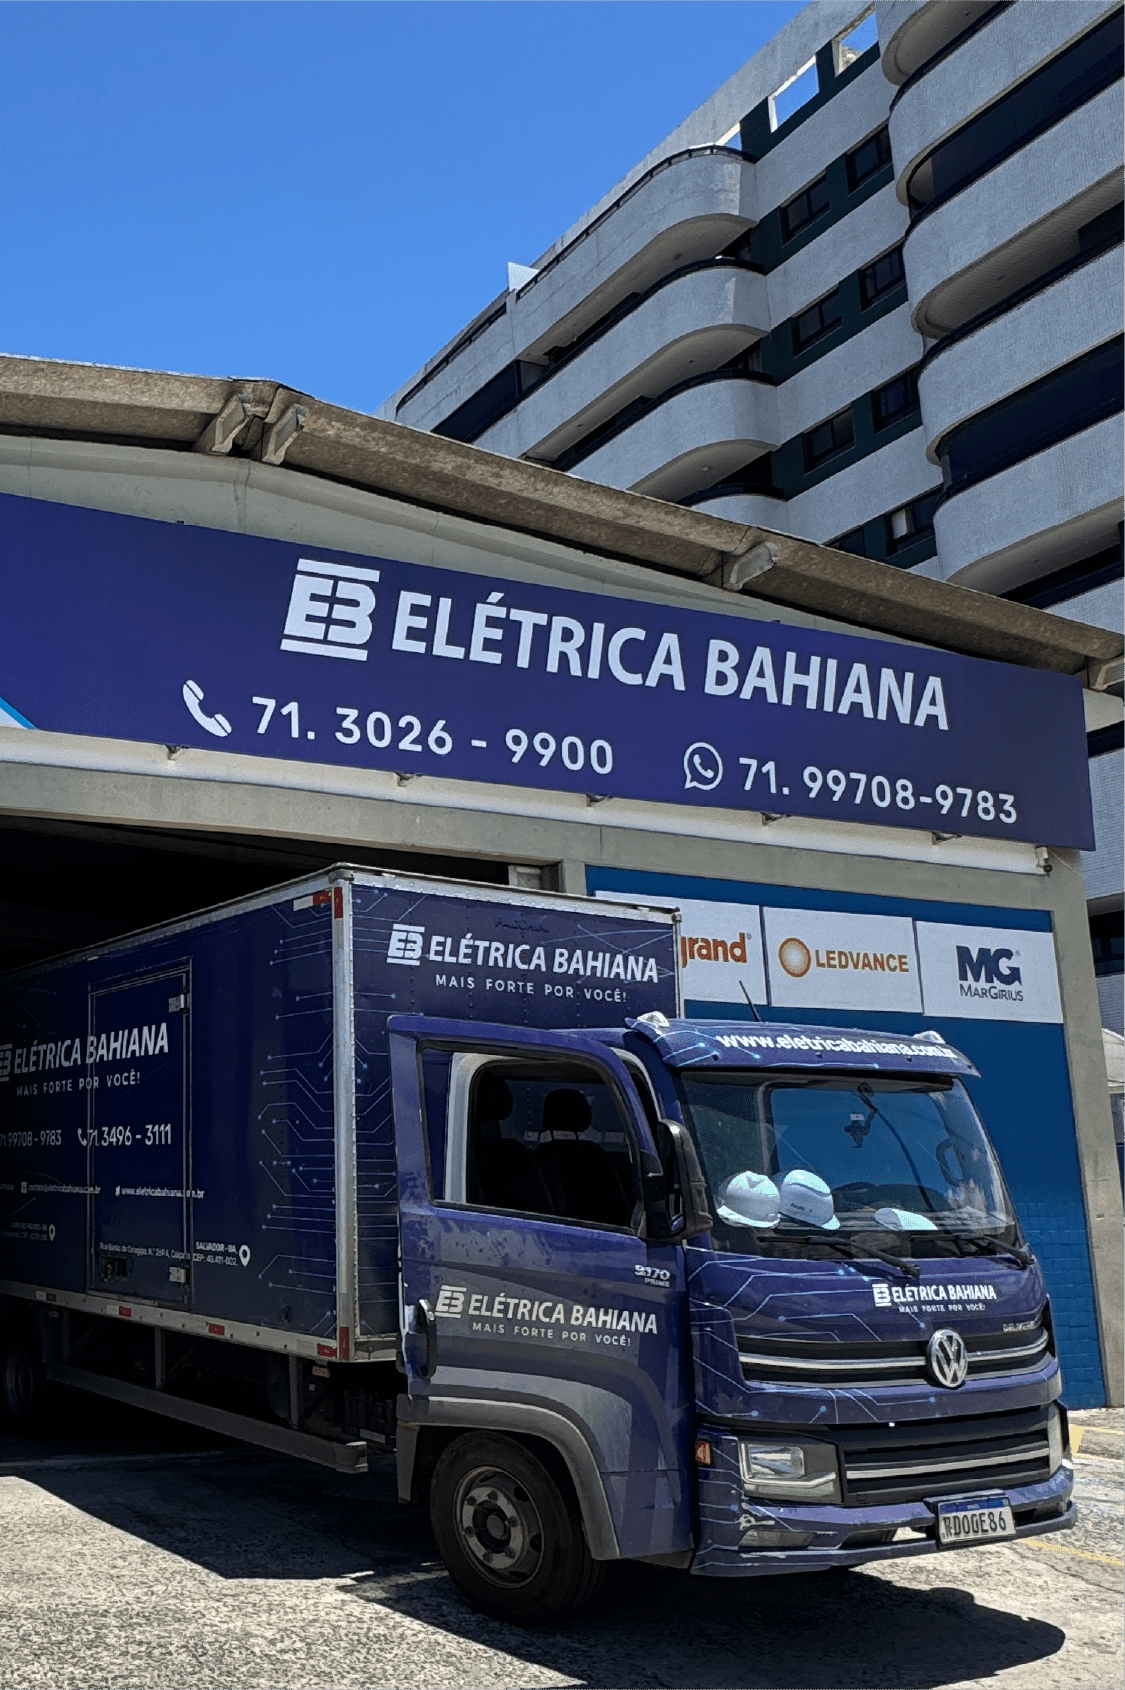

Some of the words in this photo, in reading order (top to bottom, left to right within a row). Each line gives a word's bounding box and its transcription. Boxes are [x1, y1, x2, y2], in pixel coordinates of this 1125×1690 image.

[391, 592, 686, 691] ELÉTRICA
[703, 638, 949, 731] BAHIANA
[251, 695, 316, 741] 71.
[334, 706, 453, 756] 3026
[504, 728, 614, 775] 9900
[738, 757, 790, 796] 71.
[802, 766, 1017, 825] 99708-9783
[428, 932, 547, 972] ELÉTRICA
[552, 948, 660, 984] BAHIANA
[814, 949, 910, 974] LEDVANCE
[955, 944, 1023, 987] MG
[435, 974, 475, 990] MAIS
[485, 979, 536, 995] FORTE
[544, 983, 574, 999] POR
[583, 986, 628, 1004] VOCÊ!
[13, 1038, 82, 1074] ELÉTRICA
[85, 1022, 169, 1064] BAHIANA
[16, 1085, 38, 1097] MAIS
[43, 1079, 73, 1095] FORTE
[78, 1076, 100, 1091] POR
[105, 1068, 141, 1088] VOCÊ!
[101, 1126, 133, 1147] 3496
[144, 1123, 172, 1146] 3111
[468, 1292, 565, 1325] ELÉTRICA
[570, 1304, 659, 1335] BAHIANA
[891, 1283, 946, 1303] ELÉTRICA
[946, 1283, 998, 1301] BAHIANA
[472, 1321, 505, 1334] MAIS
[513, 1325, 554, 1339] FORTE
[561, 1330, 587, 1342] POR
[594, 1334, 632, 1347] VOCÊ!
